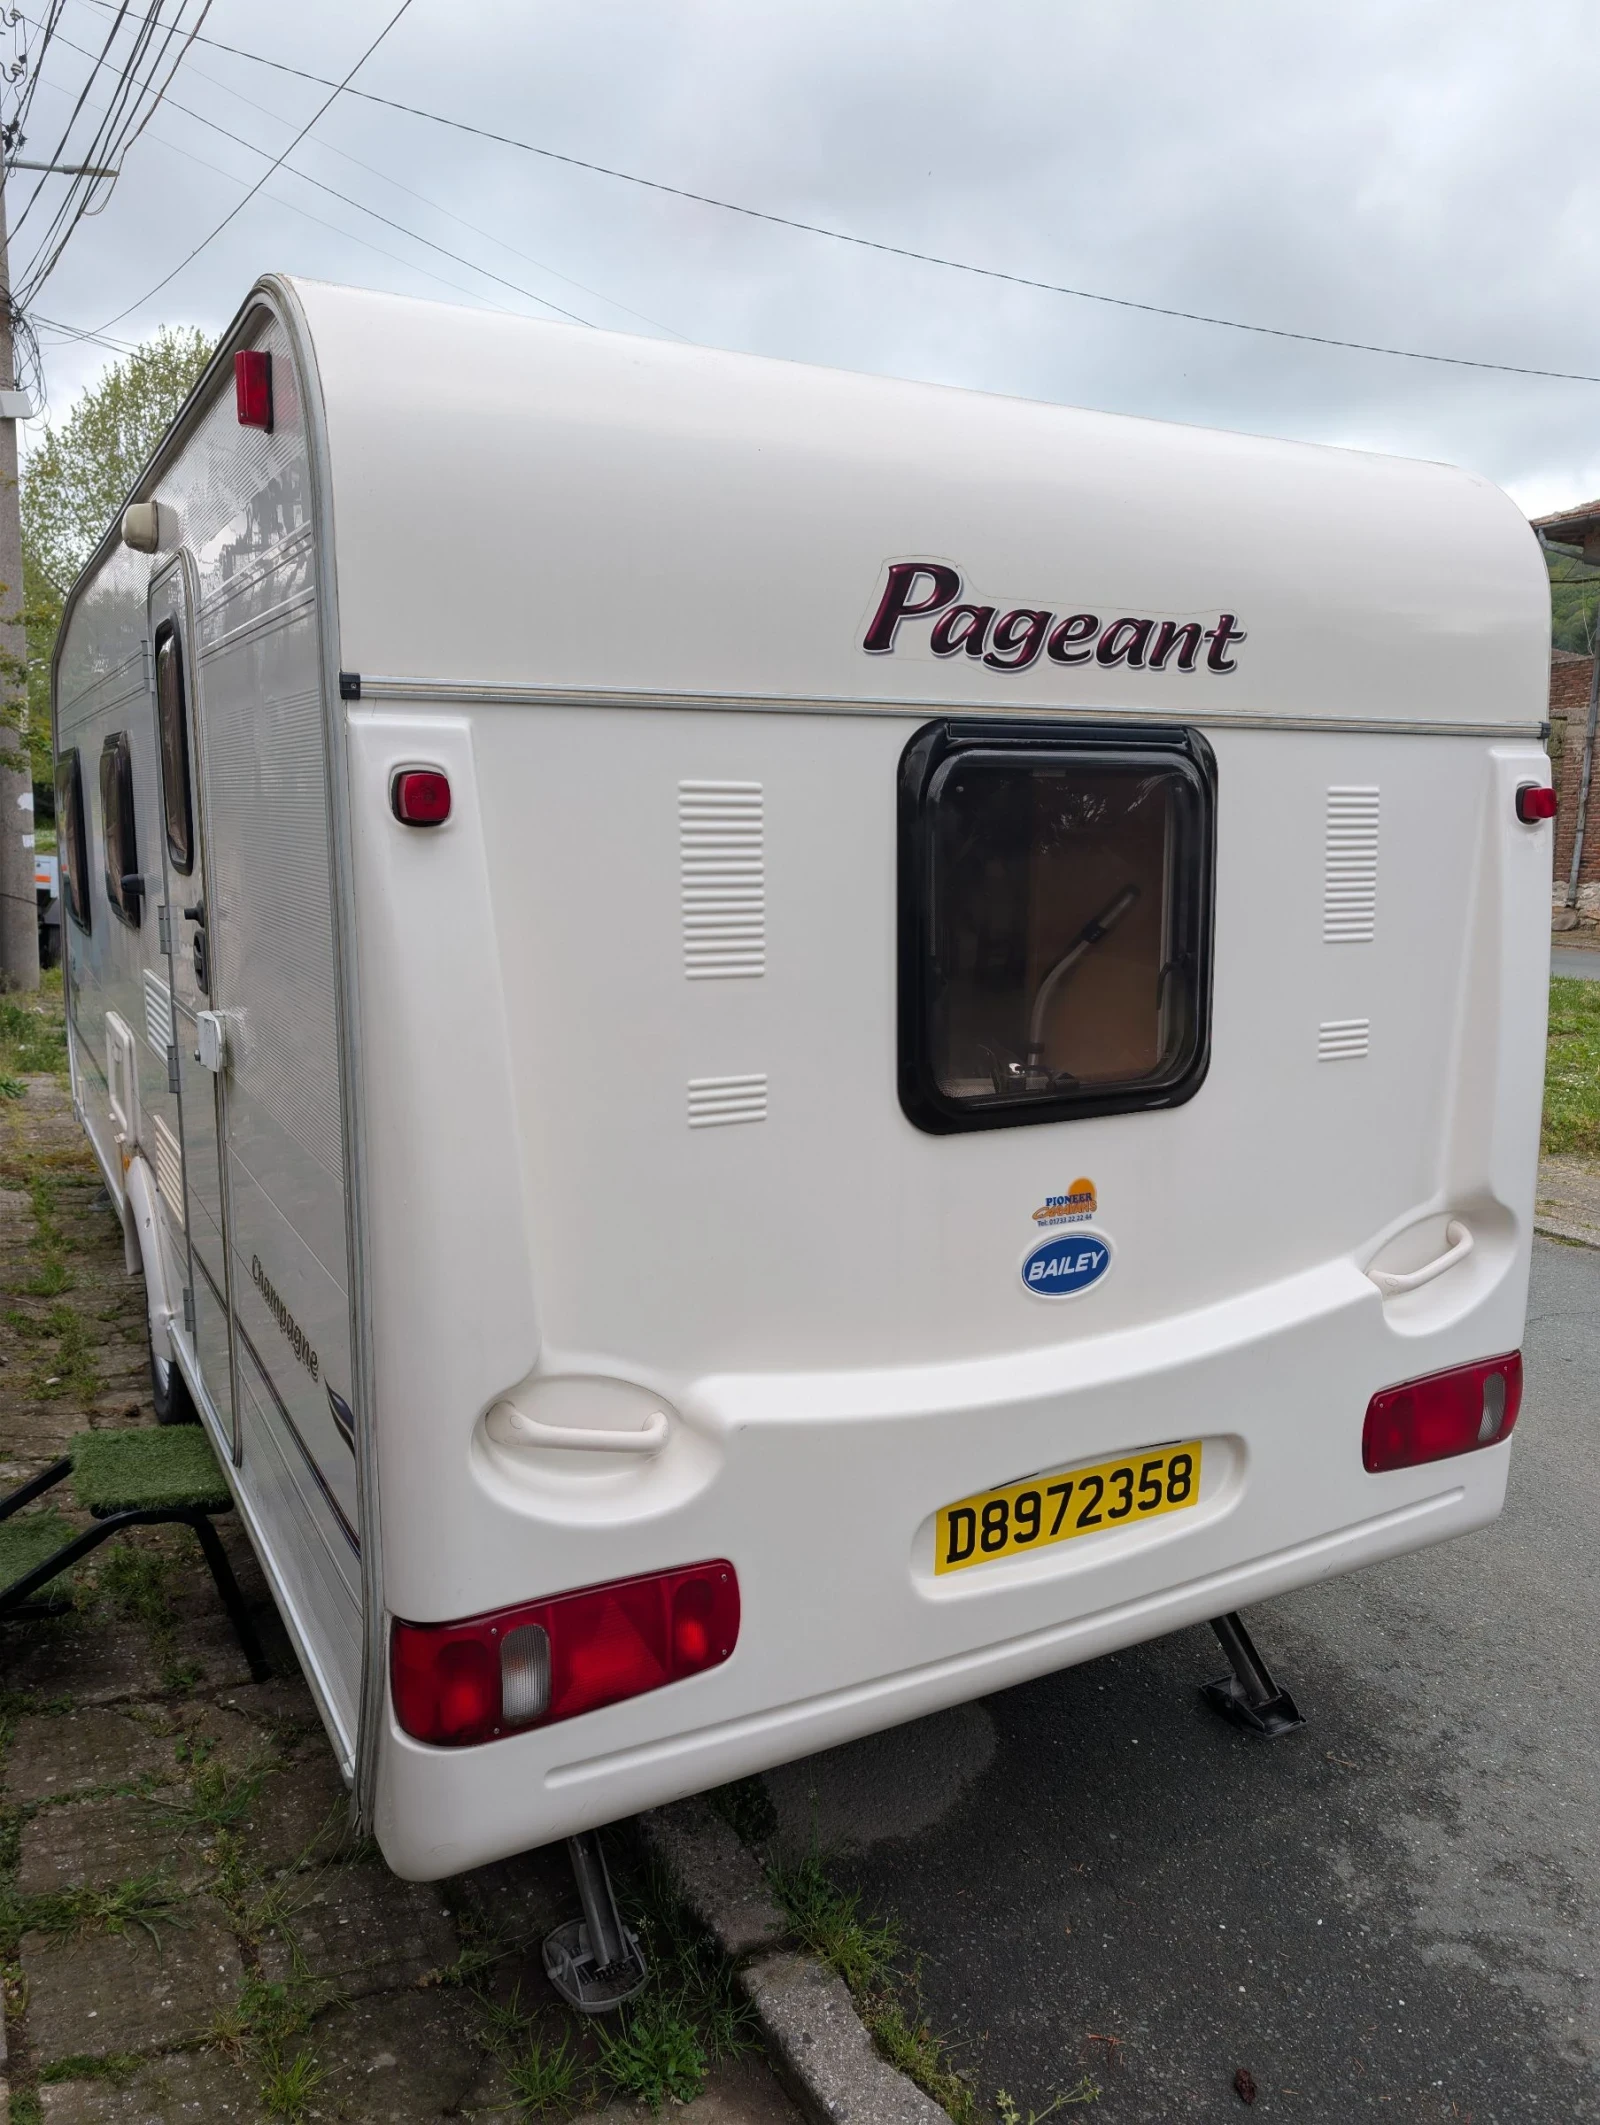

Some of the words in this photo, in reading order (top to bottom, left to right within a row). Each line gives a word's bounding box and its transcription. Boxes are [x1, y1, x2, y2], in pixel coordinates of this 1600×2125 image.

[862, 562, 1245, 673] Pageant
[1045, 1192, 1093, 1207] PIONEER
[1049, 1216, 1067, 1226] 01733
[1068, 1215, 1076, 1223] 22
[1077, 1214, 1084, 1222] 22
[1028, 1249, 1105, 1281] BAILEY
[252, 1254, 318, 1381] Champagne
[946, 1453, 1193, 1565] D8972358
